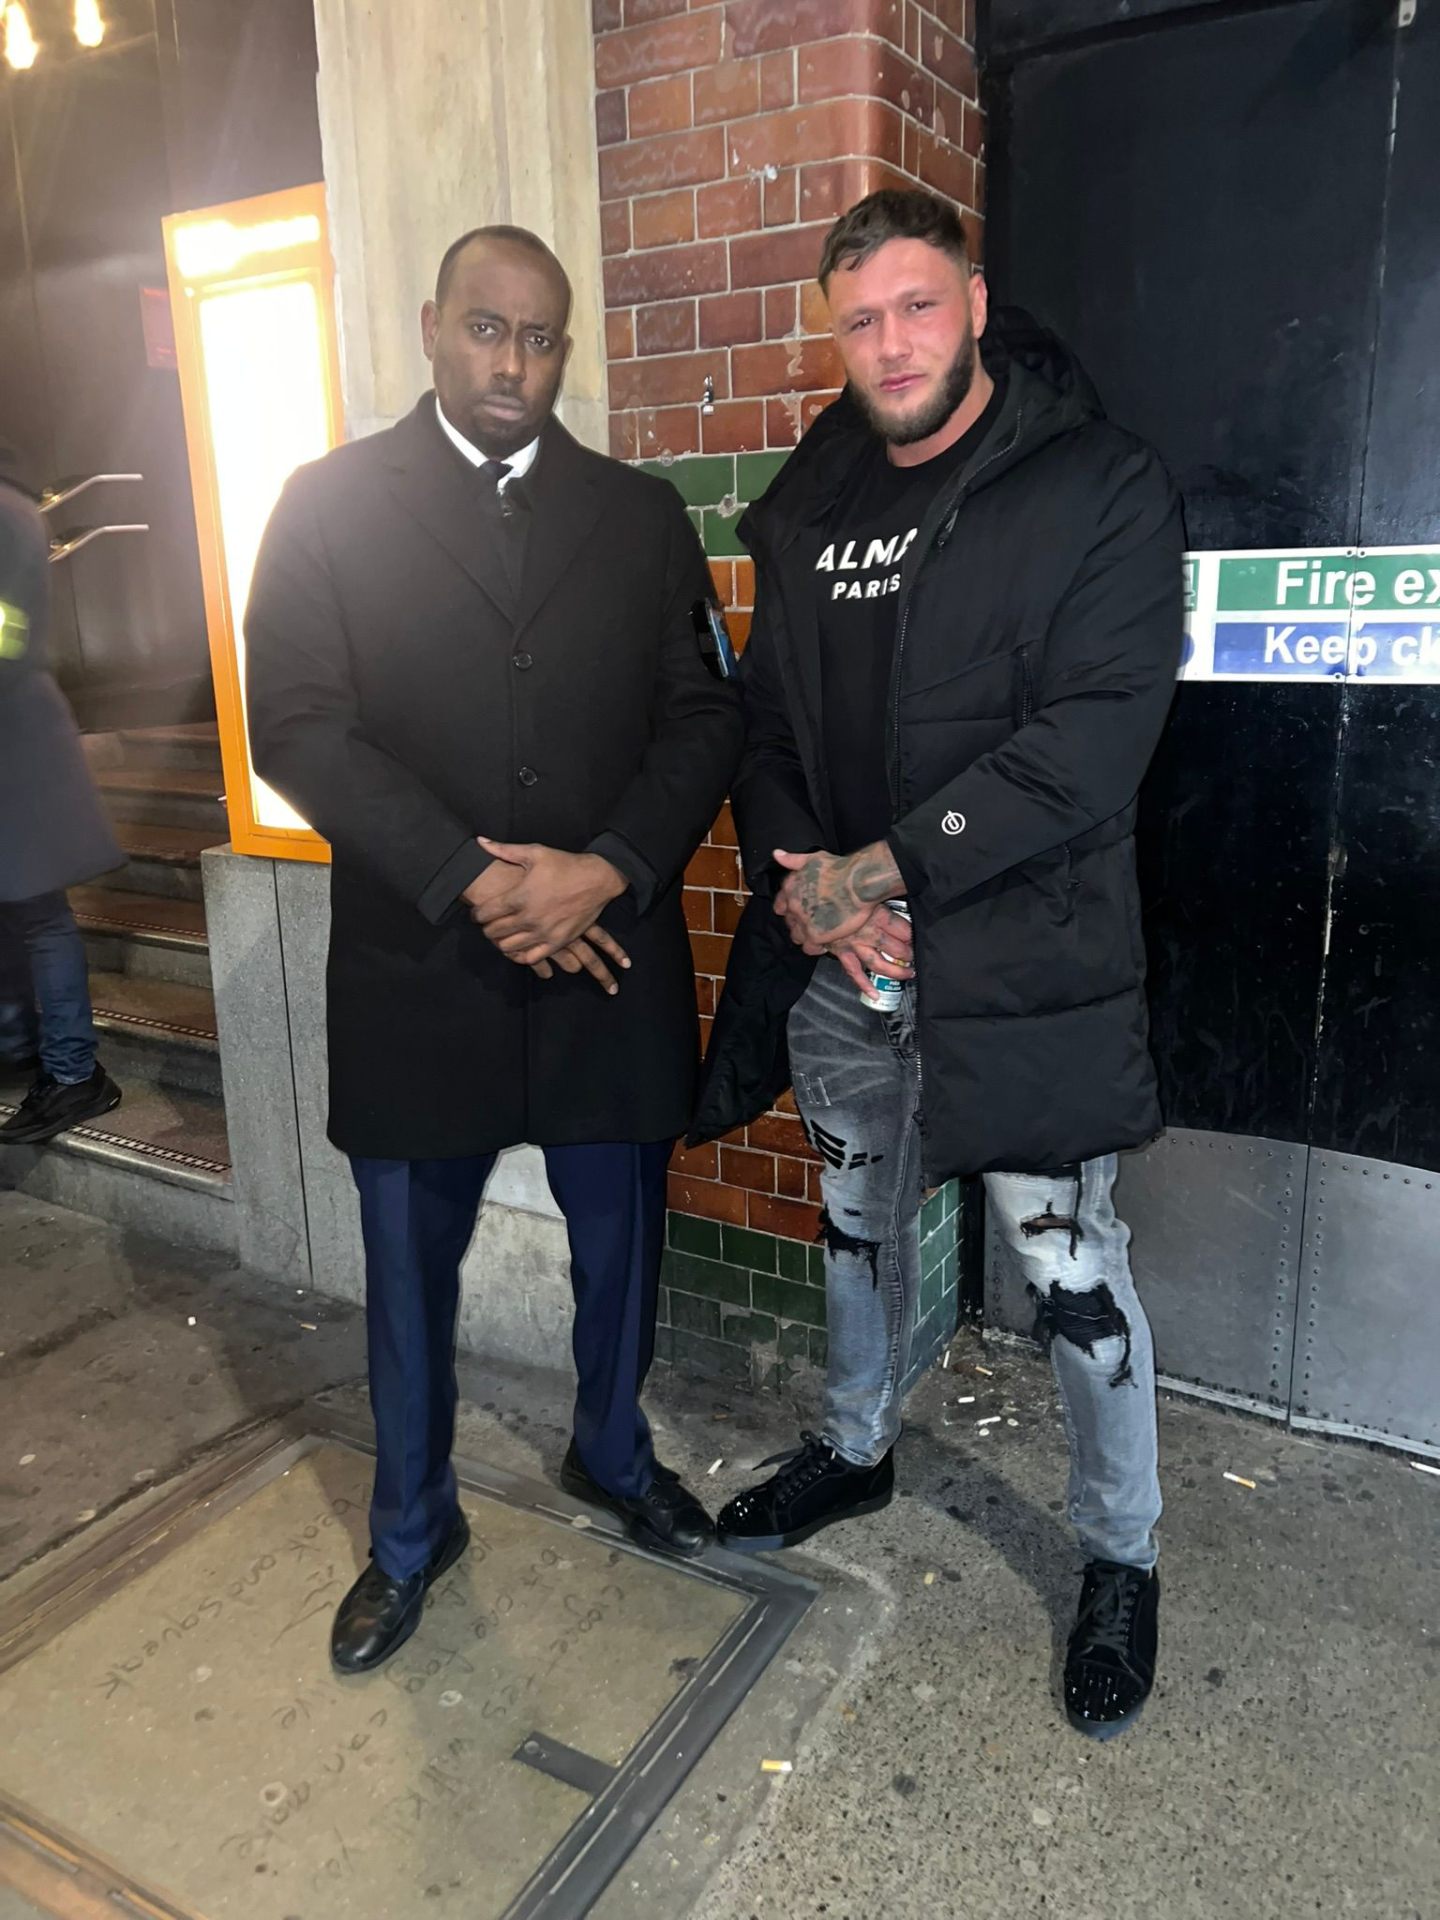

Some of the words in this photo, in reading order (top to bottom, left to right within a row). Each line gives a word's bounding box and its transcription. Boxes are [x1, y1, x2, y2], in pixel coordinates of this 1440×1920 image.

[832, 573, 901, 601] PARIS
[1276, 560, 1376, 605] Fire
[1264, 626, 1377, 675] Keep
[1392, 626, 1440, 667] cl
